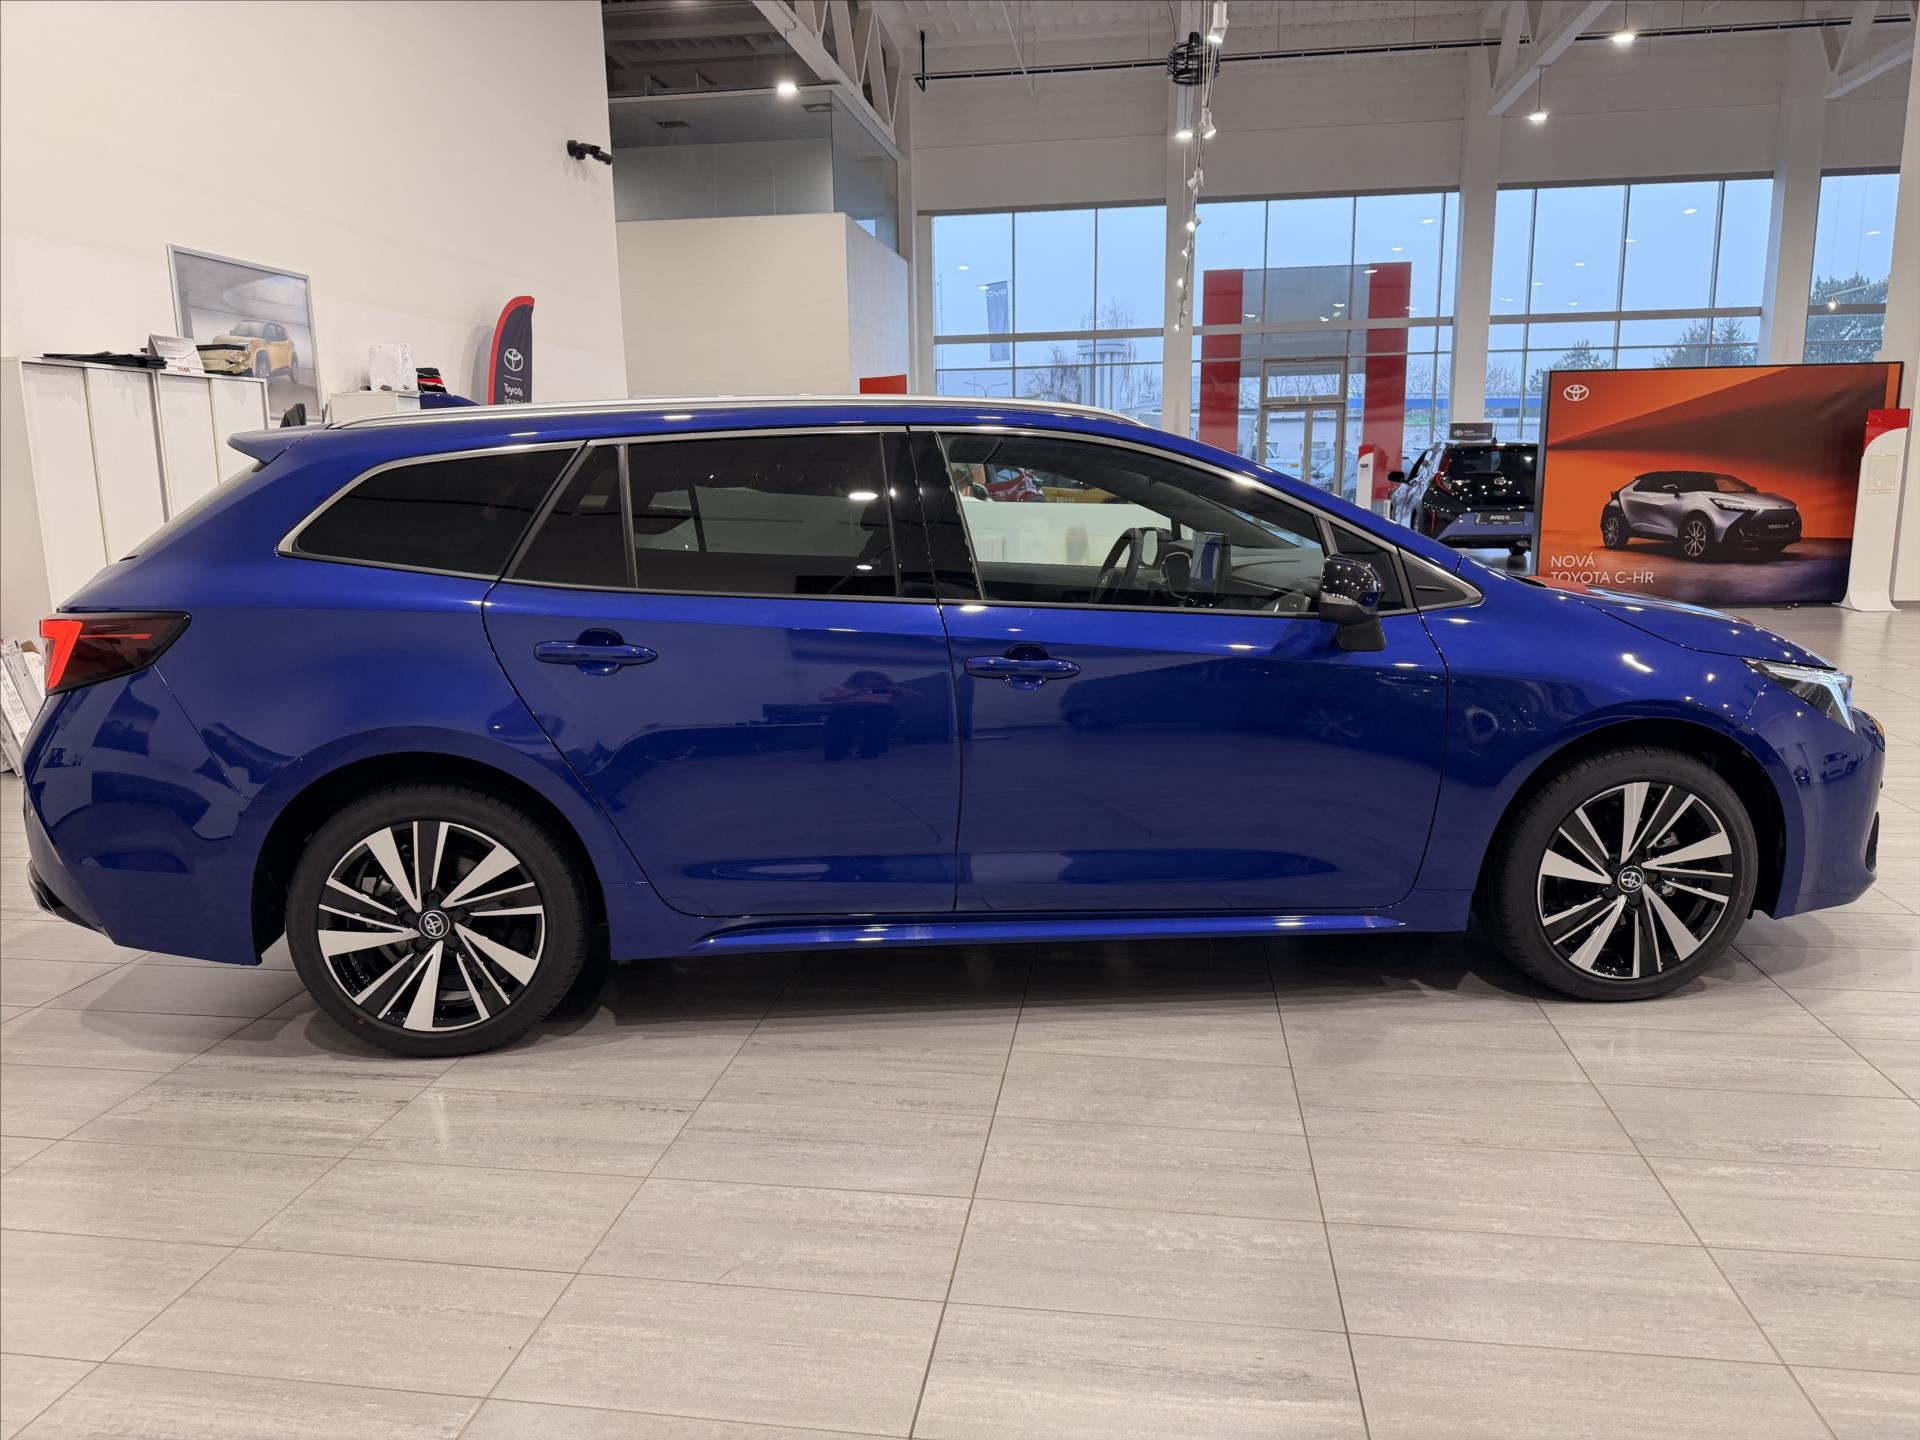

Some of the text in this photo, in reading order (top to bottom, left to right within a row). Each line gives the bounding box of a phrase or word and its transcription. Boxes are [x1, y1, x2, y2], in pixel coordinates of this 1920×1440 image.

[1550, 552, 1596, 568] NOVÁ
[1550, 571, 1655, 584] TOYOTA C-HR
